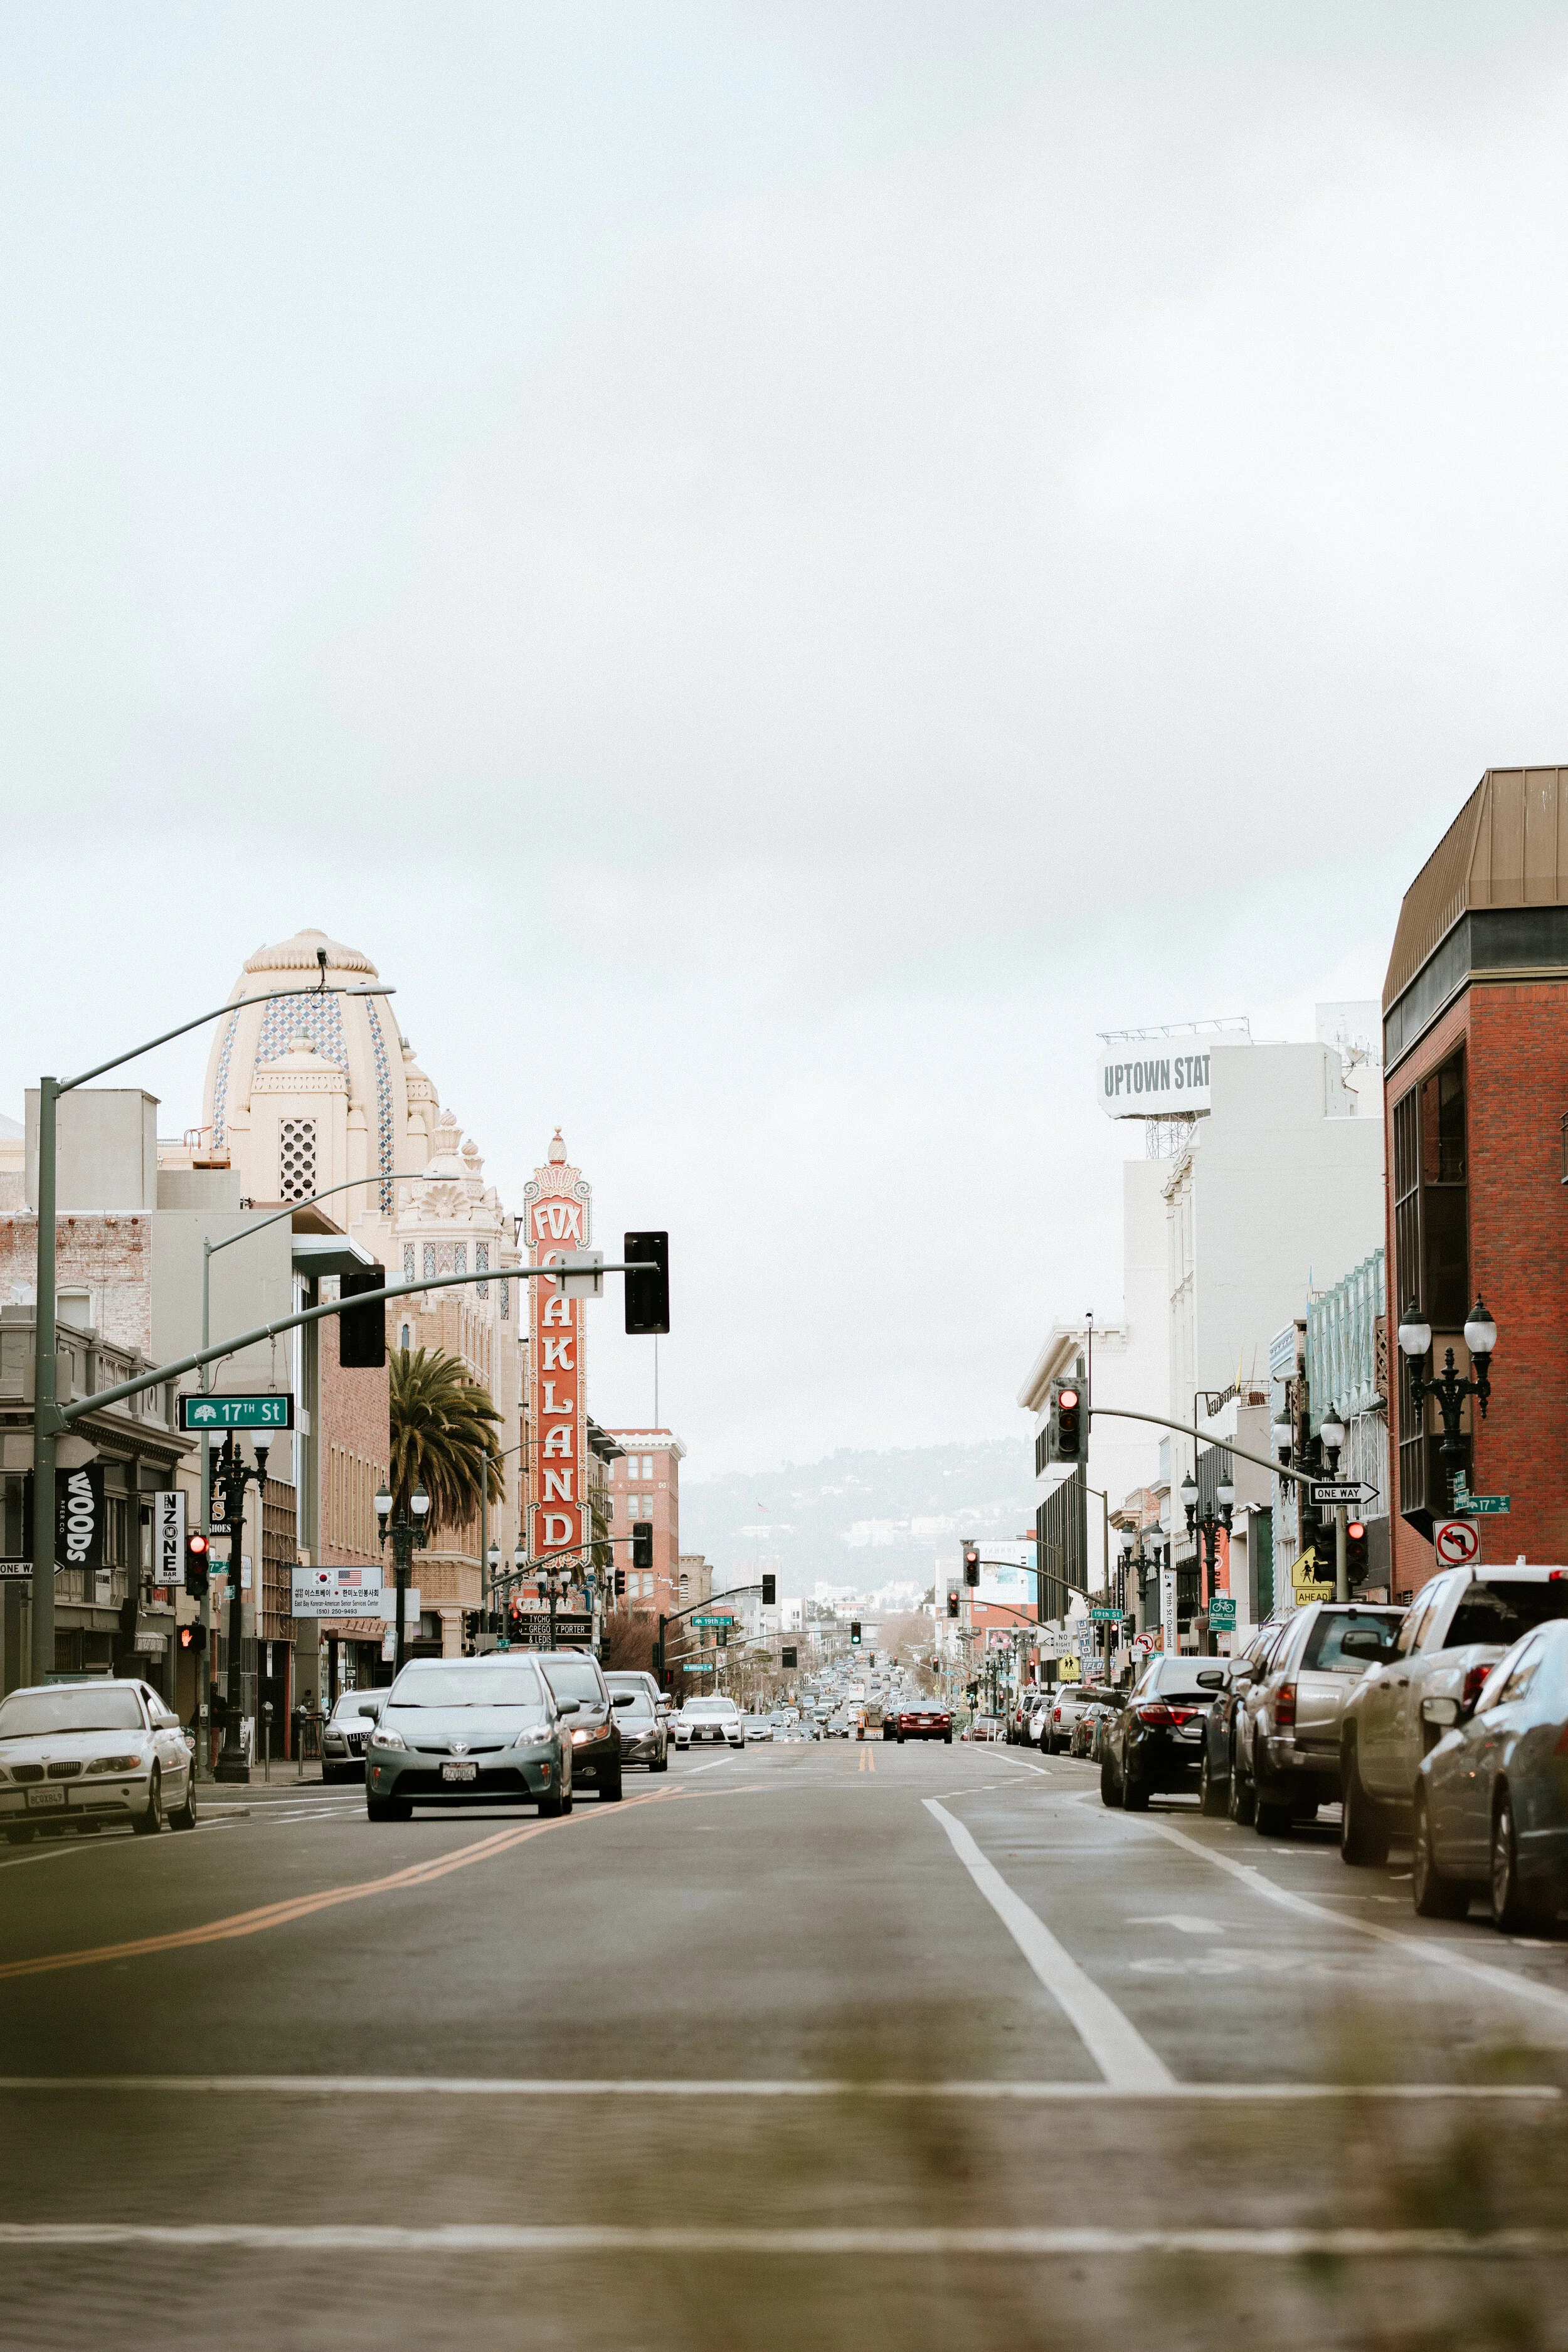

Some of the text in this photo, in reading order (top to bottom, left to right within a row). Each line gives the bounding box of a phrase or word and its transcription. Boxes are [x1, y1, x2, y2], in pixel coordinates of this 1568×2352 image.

[1104, 1054, 1210, 1097] UPTOWN STAT
[533, 1202, 581, 1240] FOX
[221, 1402, 279, 1421] 17TH St
[1318, 1489, 1359, 1498] ONE WAY
[1480, 1500, 1496, 1511] 17th
[66, 1471, 95, 1562] WOODS
[0, 1564, 19, 1574] ONE
[209, 1563, 219, 1572] 7th
[305, 1589, 379, 1597] 이스트베이 한미노인봉사회
[1298, 1593, 1328, 1601] AHEAD
[529, 1625, 585, 1633] GREGOY PORTER
[529, 1635, 533, 1643] &
